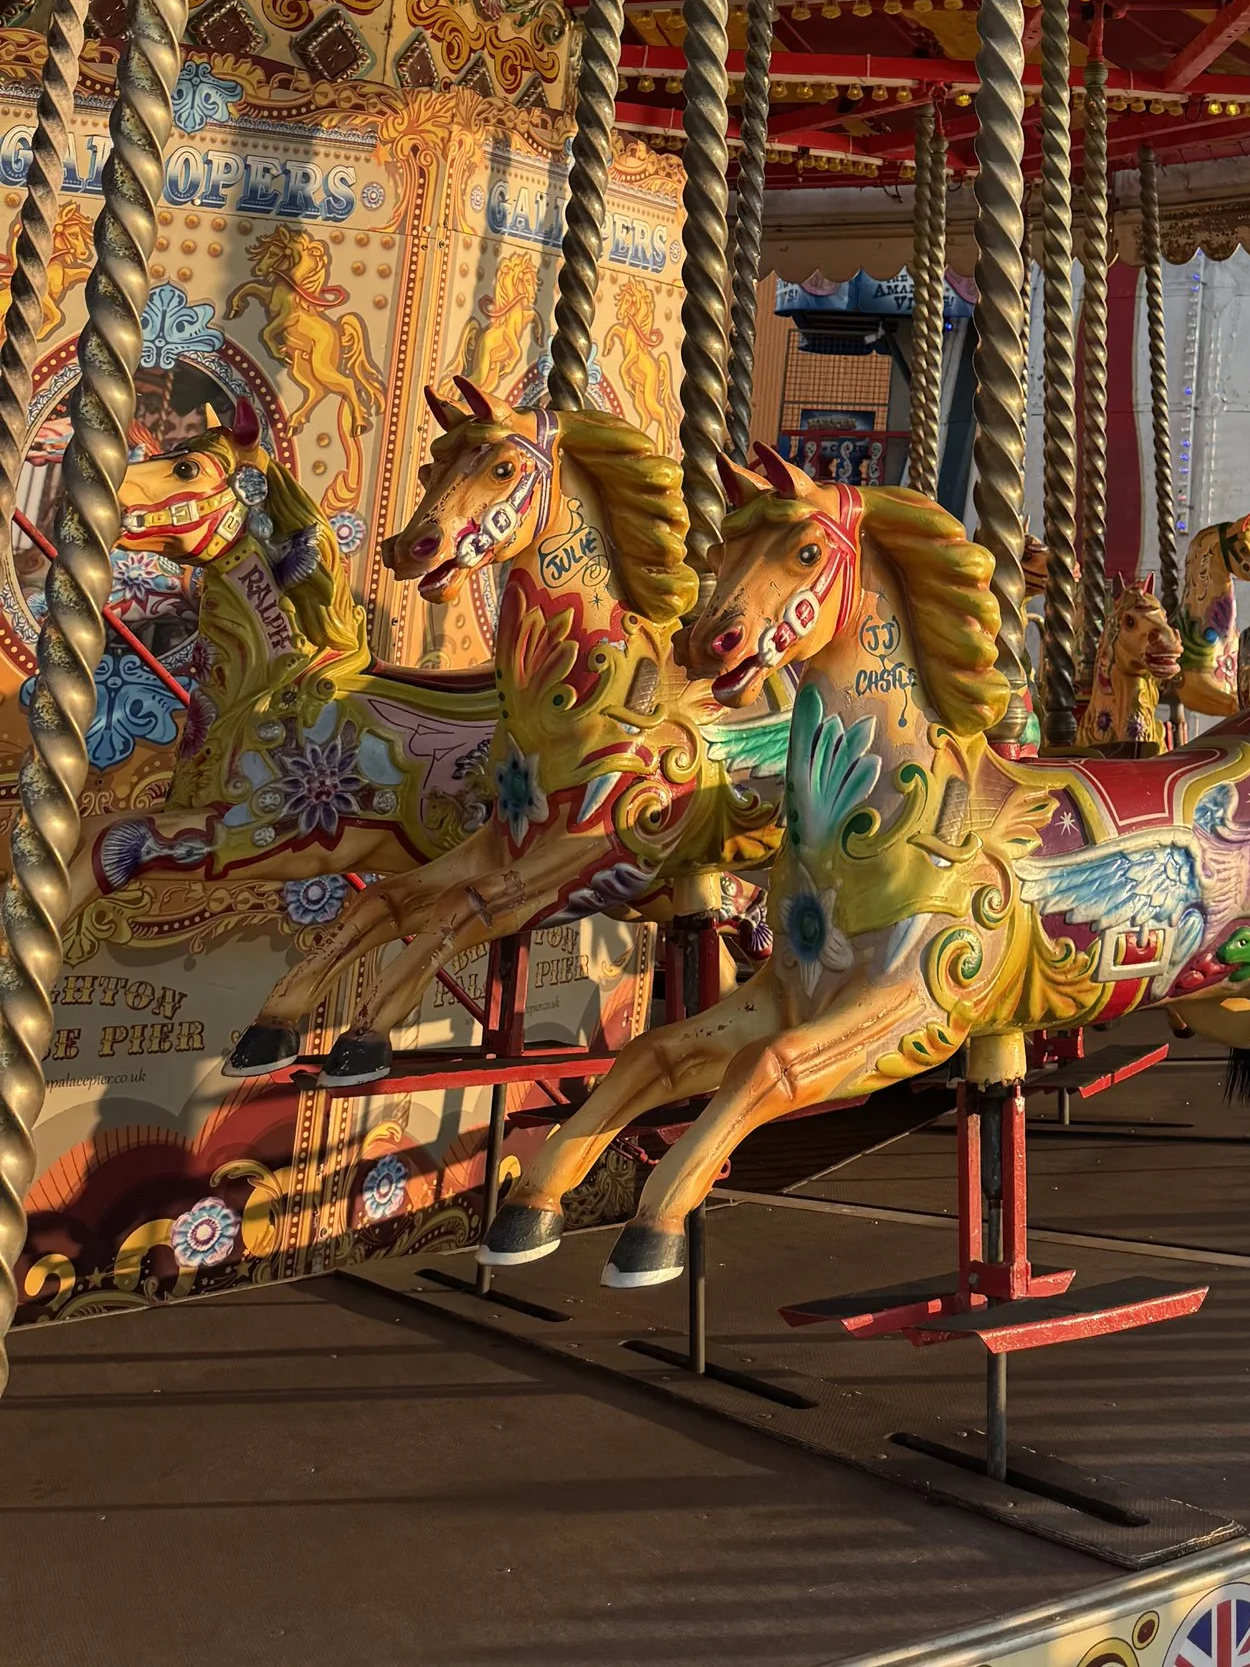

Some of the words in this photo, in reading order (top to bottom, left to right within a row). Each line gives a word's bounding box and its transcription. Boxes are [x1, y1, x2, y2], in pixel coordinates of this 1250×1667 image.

[545, 530, 598, 581] JULIE
[237, 563, 293, 650] RALPH
[865, 622, 895, 652] JJ
[534, 954, 590, 988] PIER
[98, 1020, 206, 1058] PIER
